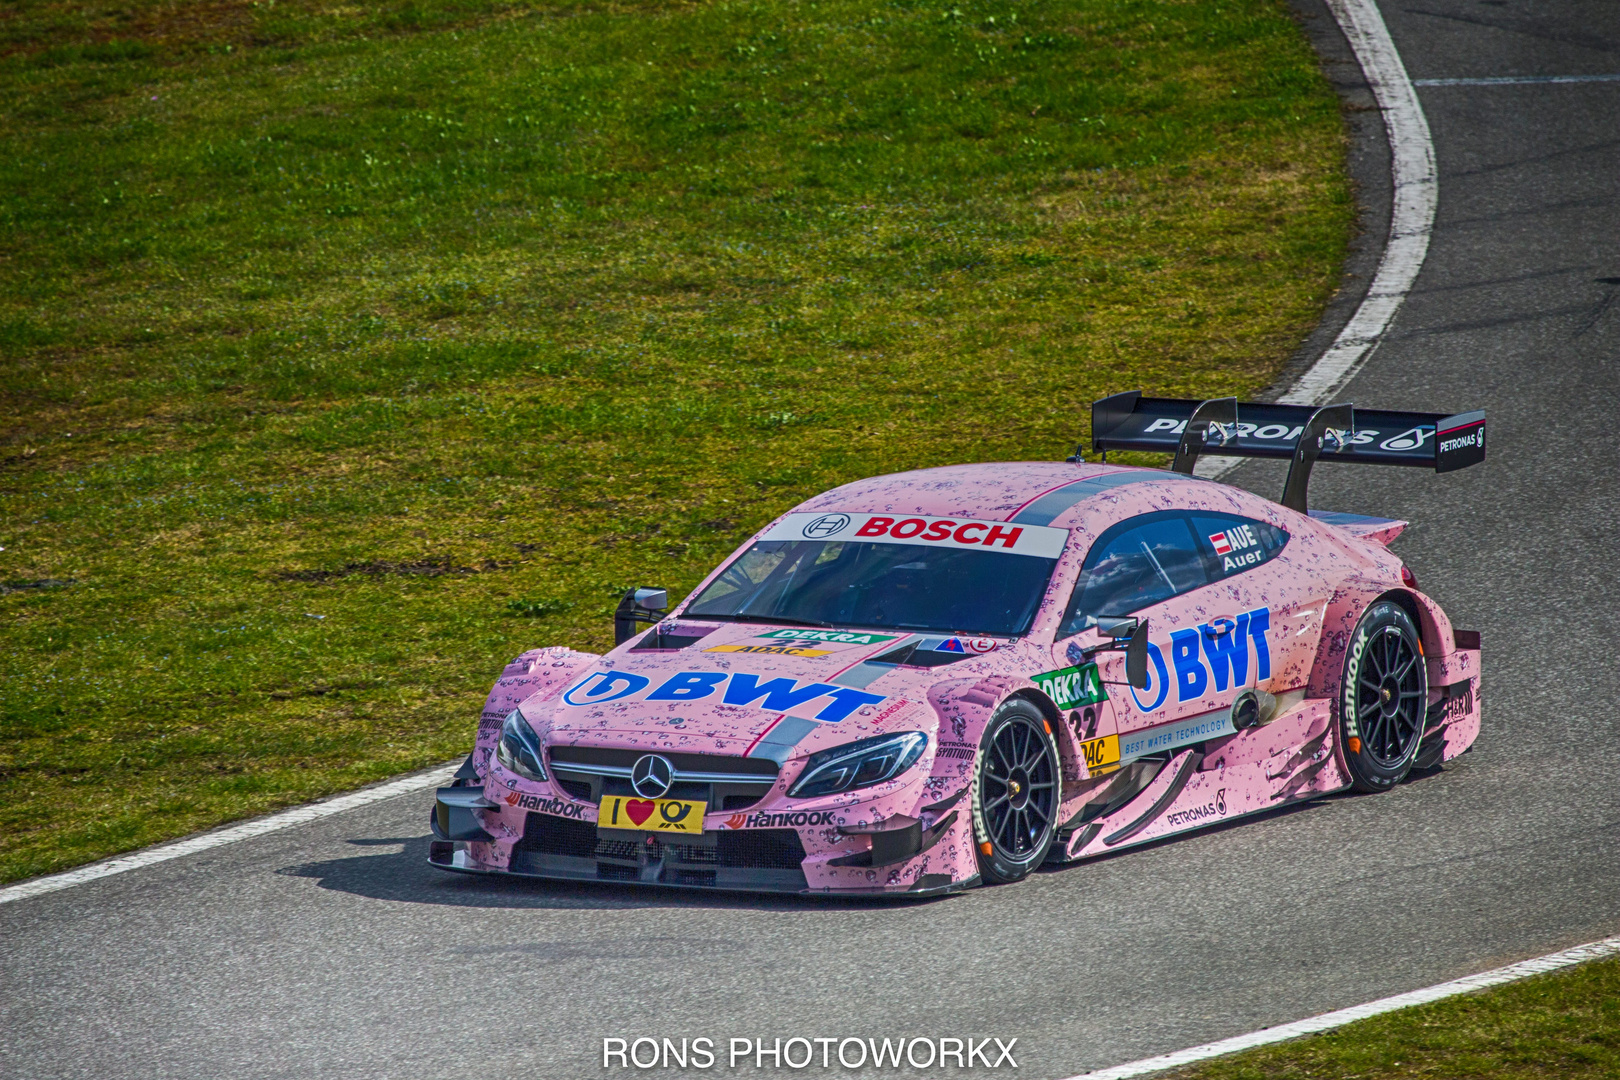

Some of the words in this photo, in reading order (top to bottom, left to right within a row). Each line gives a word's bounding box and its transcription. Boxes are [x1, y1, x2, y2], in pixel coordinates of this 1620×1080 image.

[1440, 433, 1476, 453] PETRONAS
[854, 516, 1024, 548] BOSCH
[1226, 524, 1257, 551] AUE
[1224, 550, 1262, 571] Auer
[765, 639, 822, 649] 22
[772, 629, 872, 644] DEKRA
[734, 645, 805, 656] ADAC
[1169, 606, 1271, 703] BWT
[643, 671, 888, 723] BWT
[1042, 669, 1098, 705] DEKRA
[481, 711, 508, 719] PETRONA
[1069, 707, 1096, 741] 22
[938, 741, 977, 749] PETRONAS
[1125, 740, 1144, 754] BEST
[1148, 733, 1172, 748] WATER
[1176, 719, 1226, 743] TECHNOLOGY
[935, 747, 976, 761] SYNTIUM
[611, 798, 621, 825] I
[1167, 803, 1216, 826] PETRONAS
